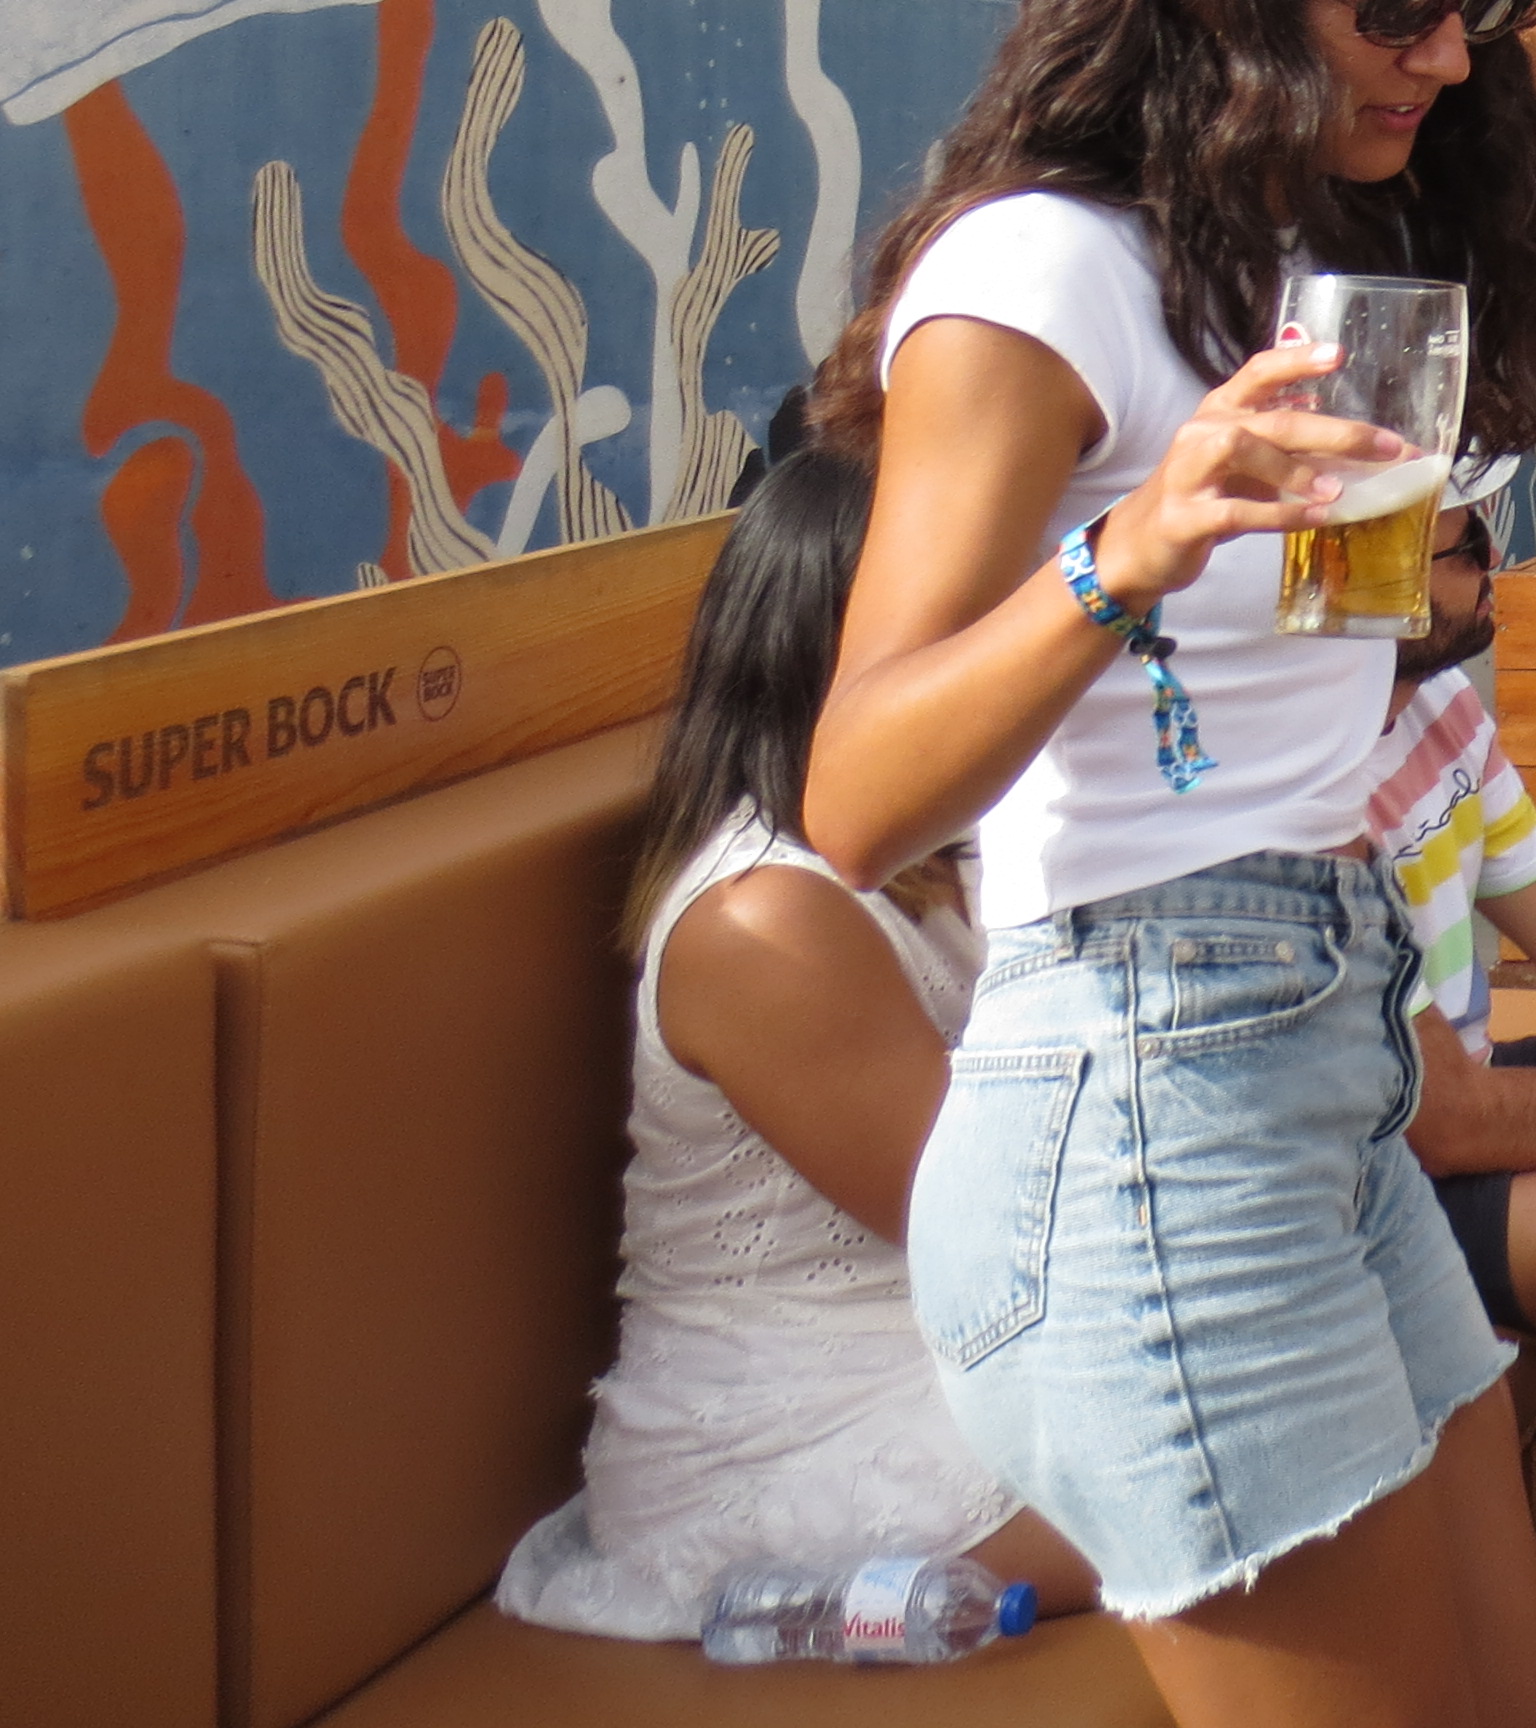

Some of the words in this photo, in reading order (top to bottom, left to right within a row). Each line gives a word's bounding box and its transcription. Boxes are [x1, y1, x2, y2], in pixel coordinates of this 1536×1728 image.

[82, 707, 253, 811] SUPER
[265, 666, 397, 759] BOCK
[844, 1611, 905, 1638] Vitalis
